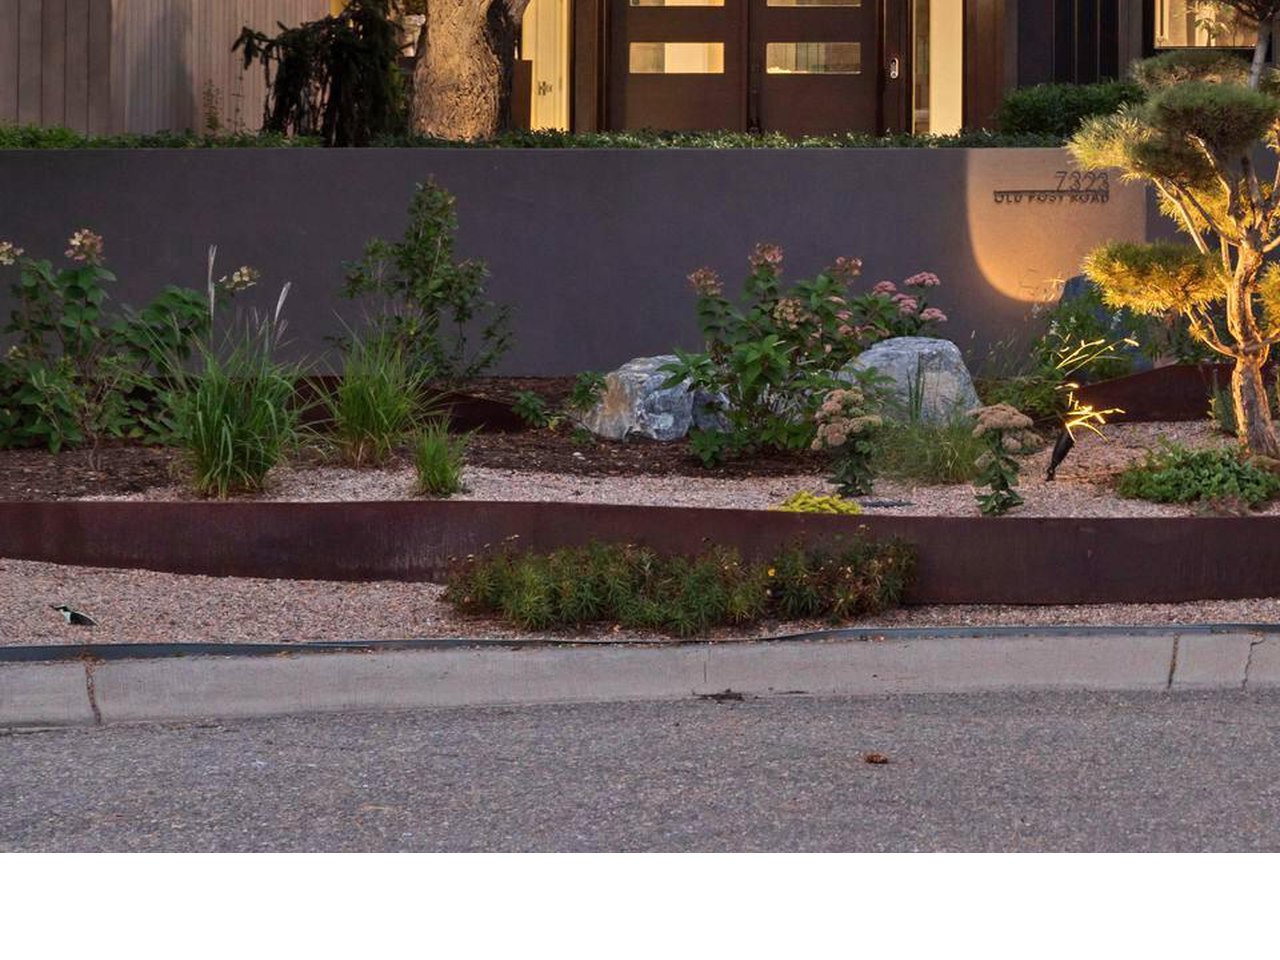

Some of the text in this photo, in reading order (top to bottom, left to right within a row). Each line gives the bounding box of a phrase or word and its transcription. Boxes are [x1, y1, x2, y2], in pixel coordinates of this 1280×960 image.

[1055, 170, 1109, 193] 7323
[993, 191, 1109, 204] OLD POST ROAD
